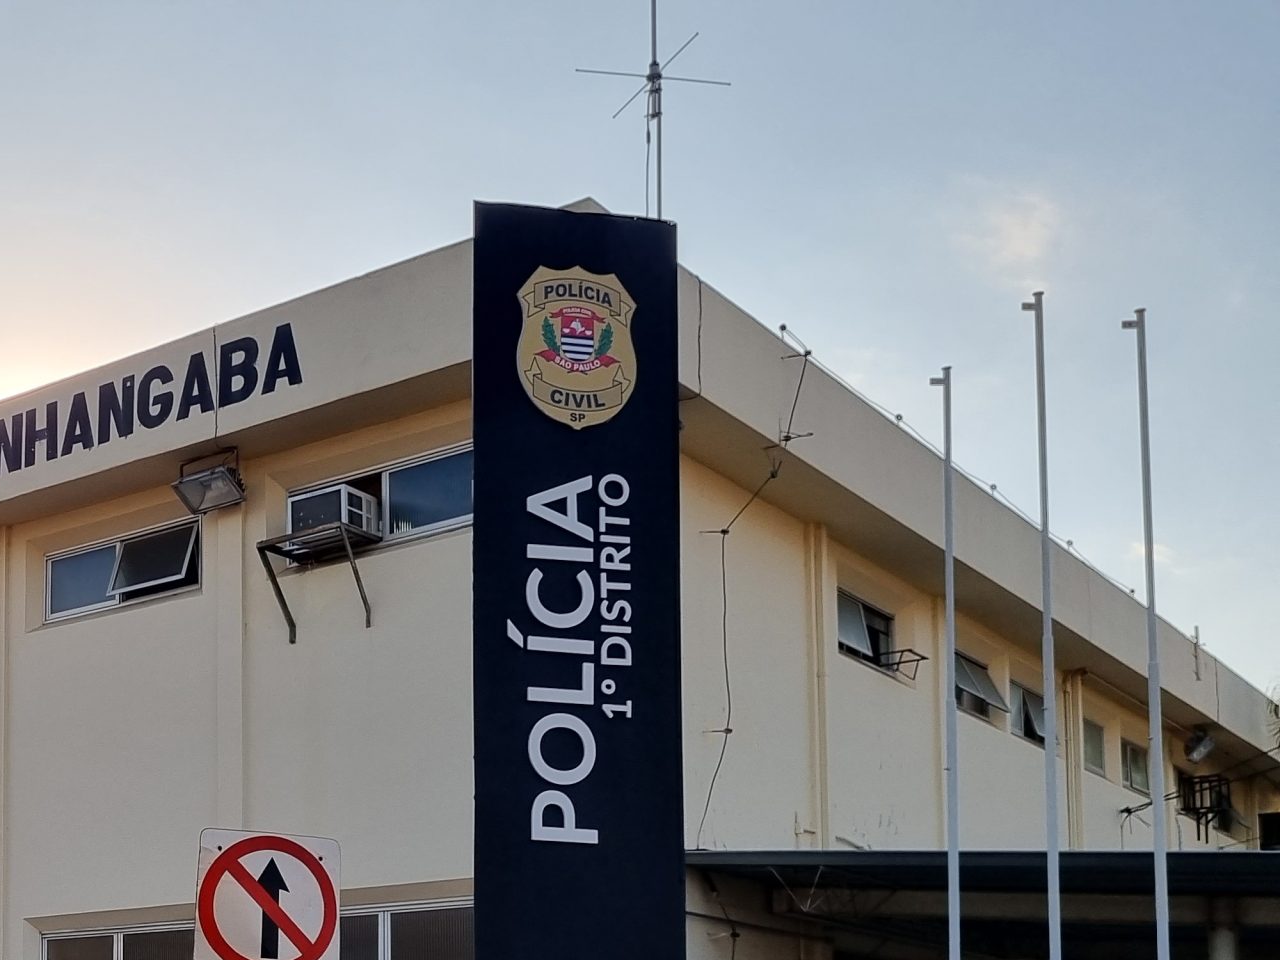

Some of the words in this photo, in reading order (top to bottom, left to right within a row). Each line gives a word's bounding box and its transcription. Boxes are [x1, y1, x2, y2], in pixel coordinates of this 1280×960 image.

[543, 282, 613, 308] POLÍCIA
[573, 359, 601, 371] PAULO
[550, 389, 606, 409] CIVIL
[570, 412, 586, 423] SP
[598, 473, 633, 667] DISTRITO
[507, 474, 599, 844] POLÍCIA
